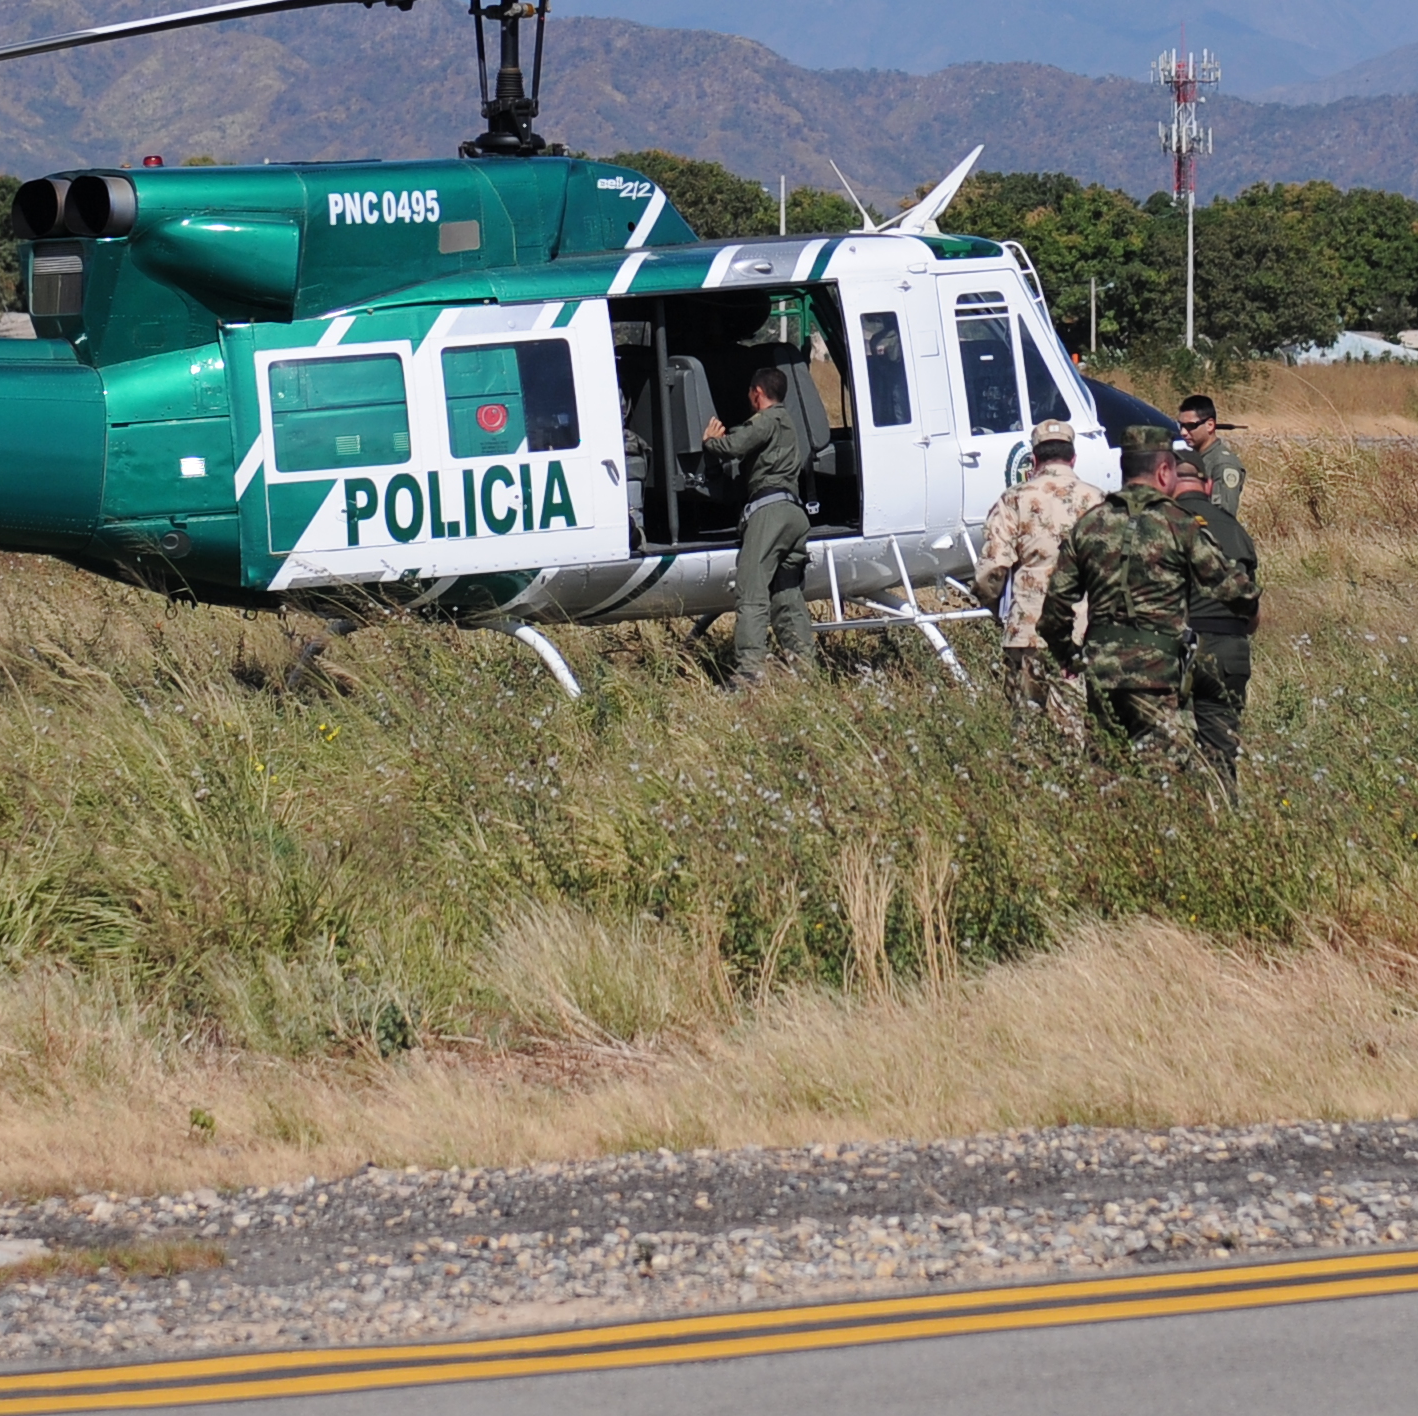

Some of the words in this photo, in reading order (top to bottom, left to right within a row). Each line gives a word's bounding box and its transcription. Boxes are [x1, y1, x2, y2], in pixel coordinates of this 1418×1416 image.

[328, 191, 379, 225] PNC
[382, 190, 440, 223] 0495
[619, 180, 653, 200] 212
[344, 460, 578, 547] POLICIA
